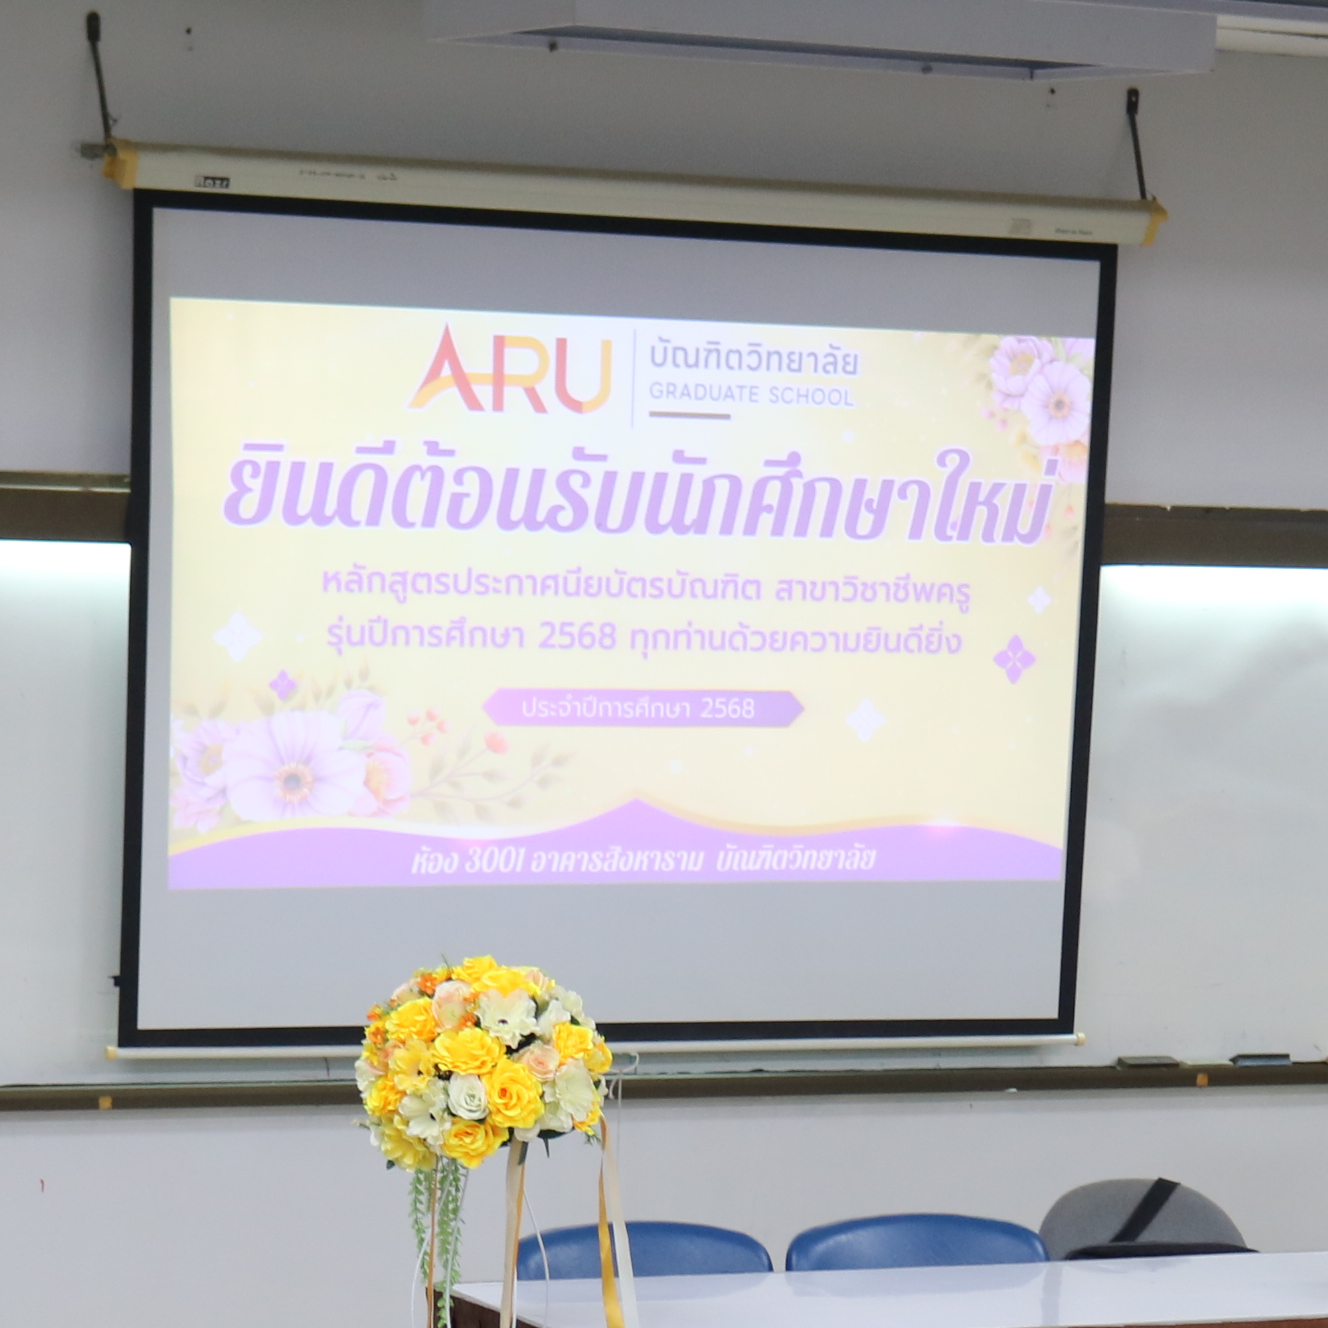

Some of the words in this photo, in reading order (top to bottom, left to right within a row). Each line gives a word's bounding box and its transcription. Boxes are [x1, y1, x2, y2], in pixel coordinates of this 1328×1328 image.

[408, 323, 612, 414] ARU
[649, 336, 860, 376] บัณฑิตวิทยาลัย
[648, 381, 760, 404] GRADUATE
[768, 385, 856, 407] SCHOOL
[223, 440, 1060, 546] ยินดีต้อนรับนักศึกษาใหม่
[322, 562, 763, 604] หลักสูตรประกาศนียบัตรบัณฑิต
[775, 573, 971, 614] สาขาวิชาชีพครู
[327, 615, 525, 656] รุ่นปีการศึกษา
[538, 620, 617, 650] 2568
[630, 620, 963, 660] ทุกท่านด้วยความยินดียิ่ง
[522, 694, 691, 719] ประจำปีการศึกษา
[700, 697, 755, 719] 2568
[410, 845, 460, 875] ห้อง
[465, 846, 525, 873] 3001
[716, 842, 878, 872] บัณฑิตวิทยาลัย
